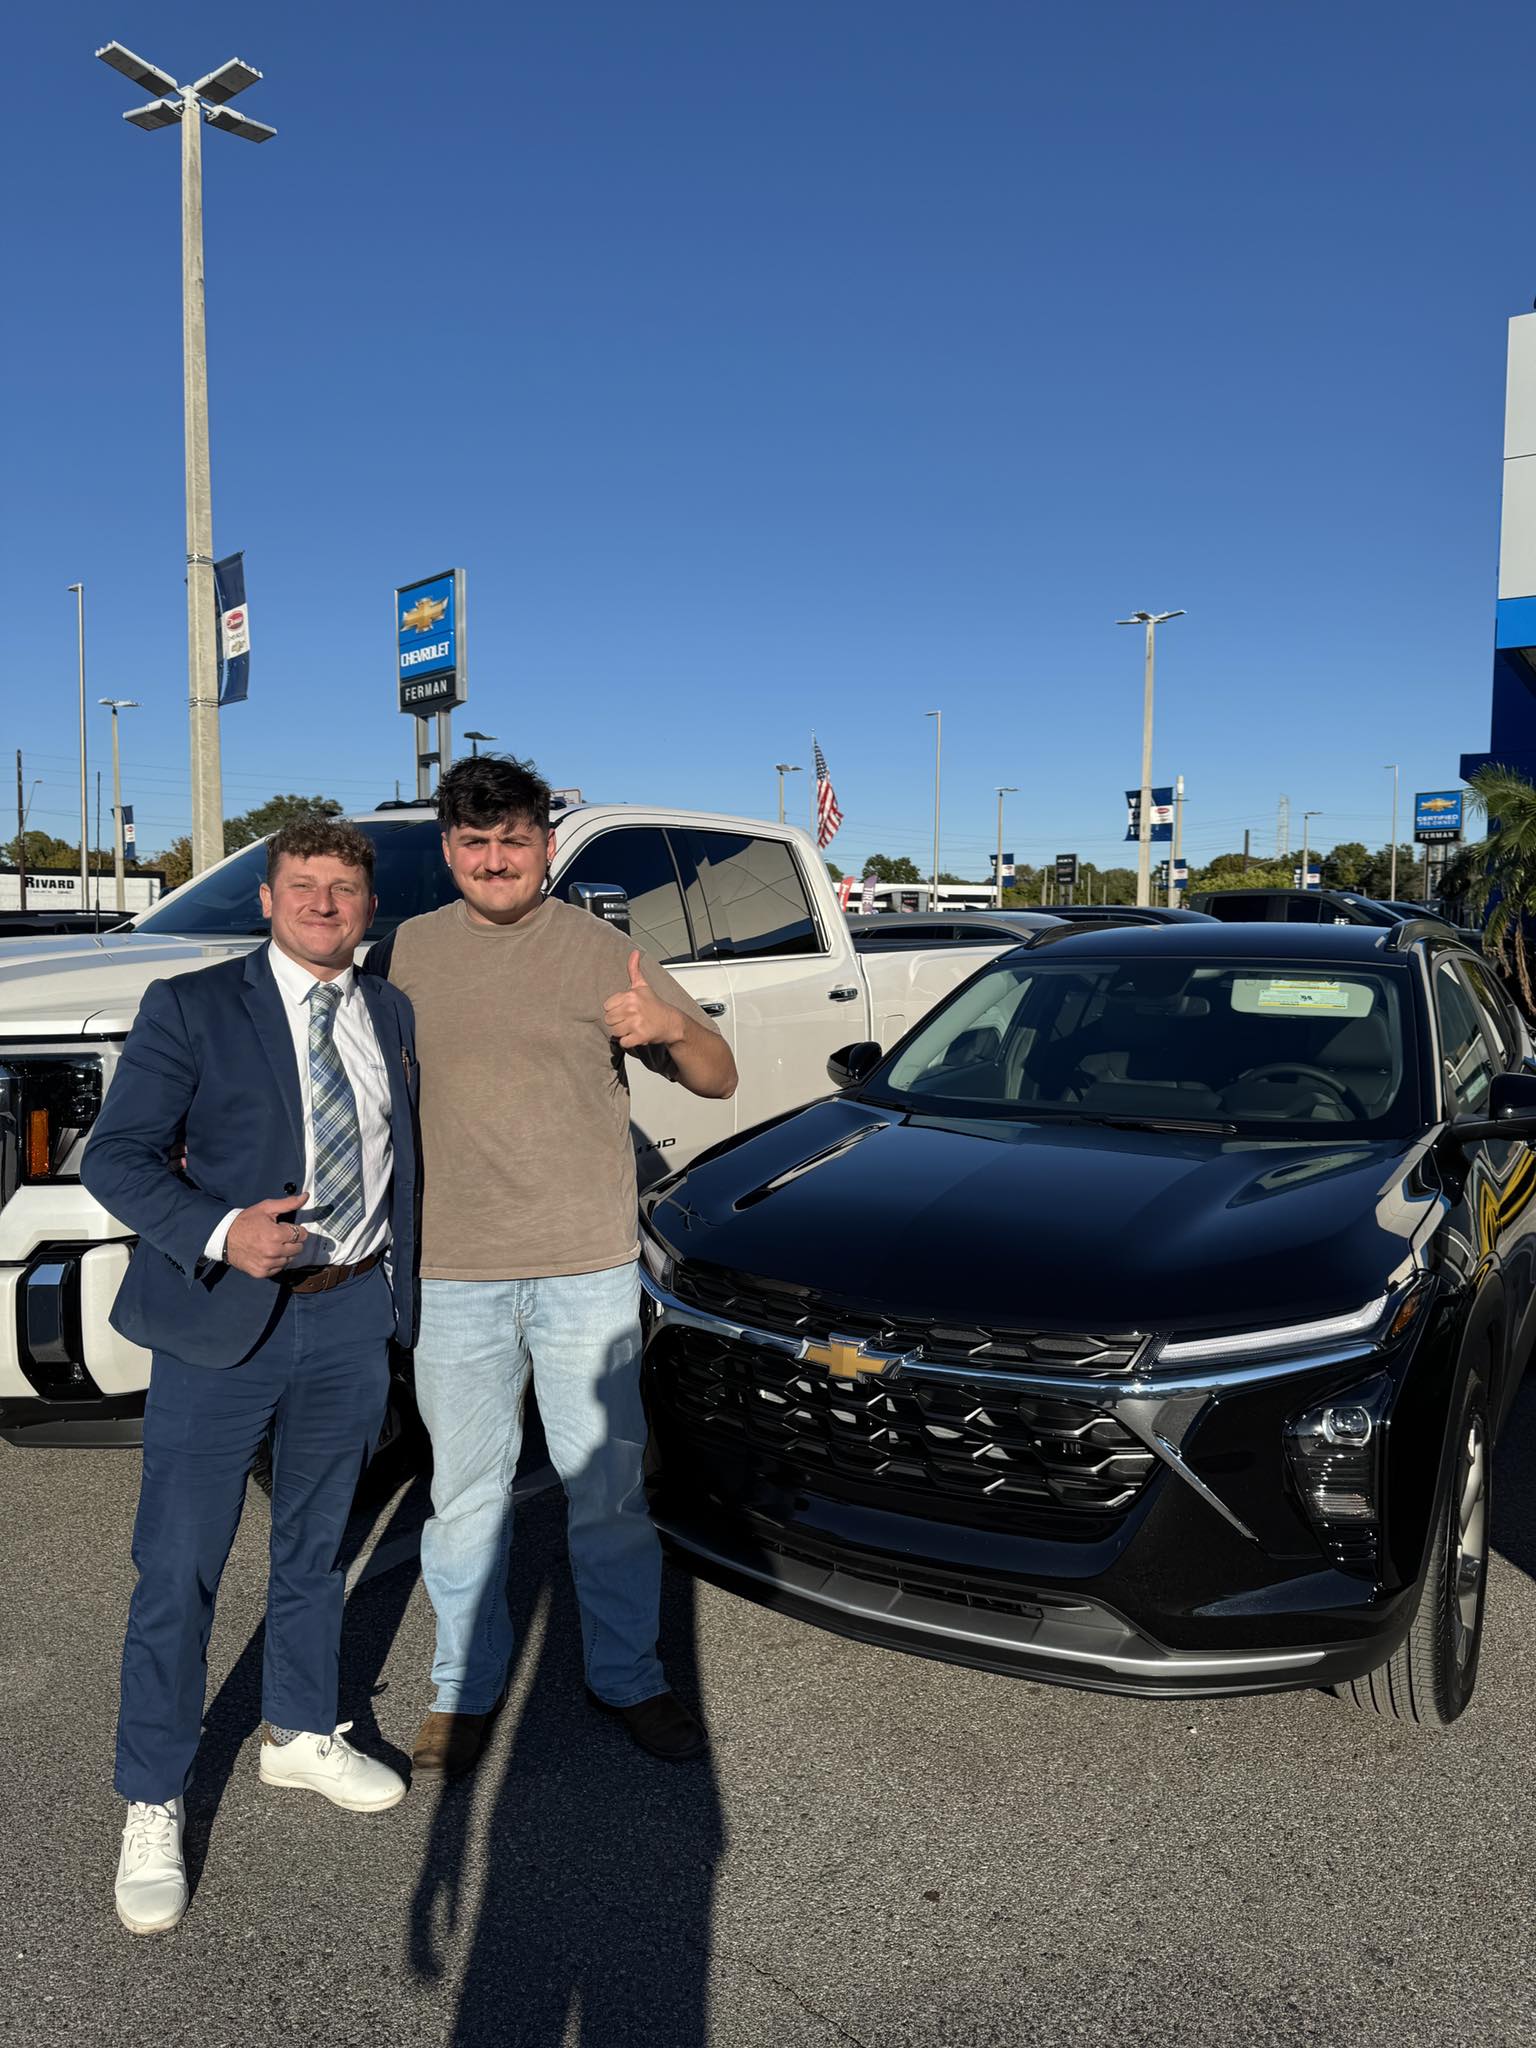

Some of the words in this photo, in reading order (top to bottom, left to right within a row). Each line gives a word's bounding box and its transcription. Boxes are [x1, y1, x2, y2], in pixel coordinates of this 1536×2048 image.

[401, 641, 450, 667] CHEVROLET
[405, 679, 448, 701] FERMAN
[1416, 814, 1459, 822] CERTIFIED
[1419, 831, 1454, 840] FERMAN
[646, 1138, 676, 1153] HD
